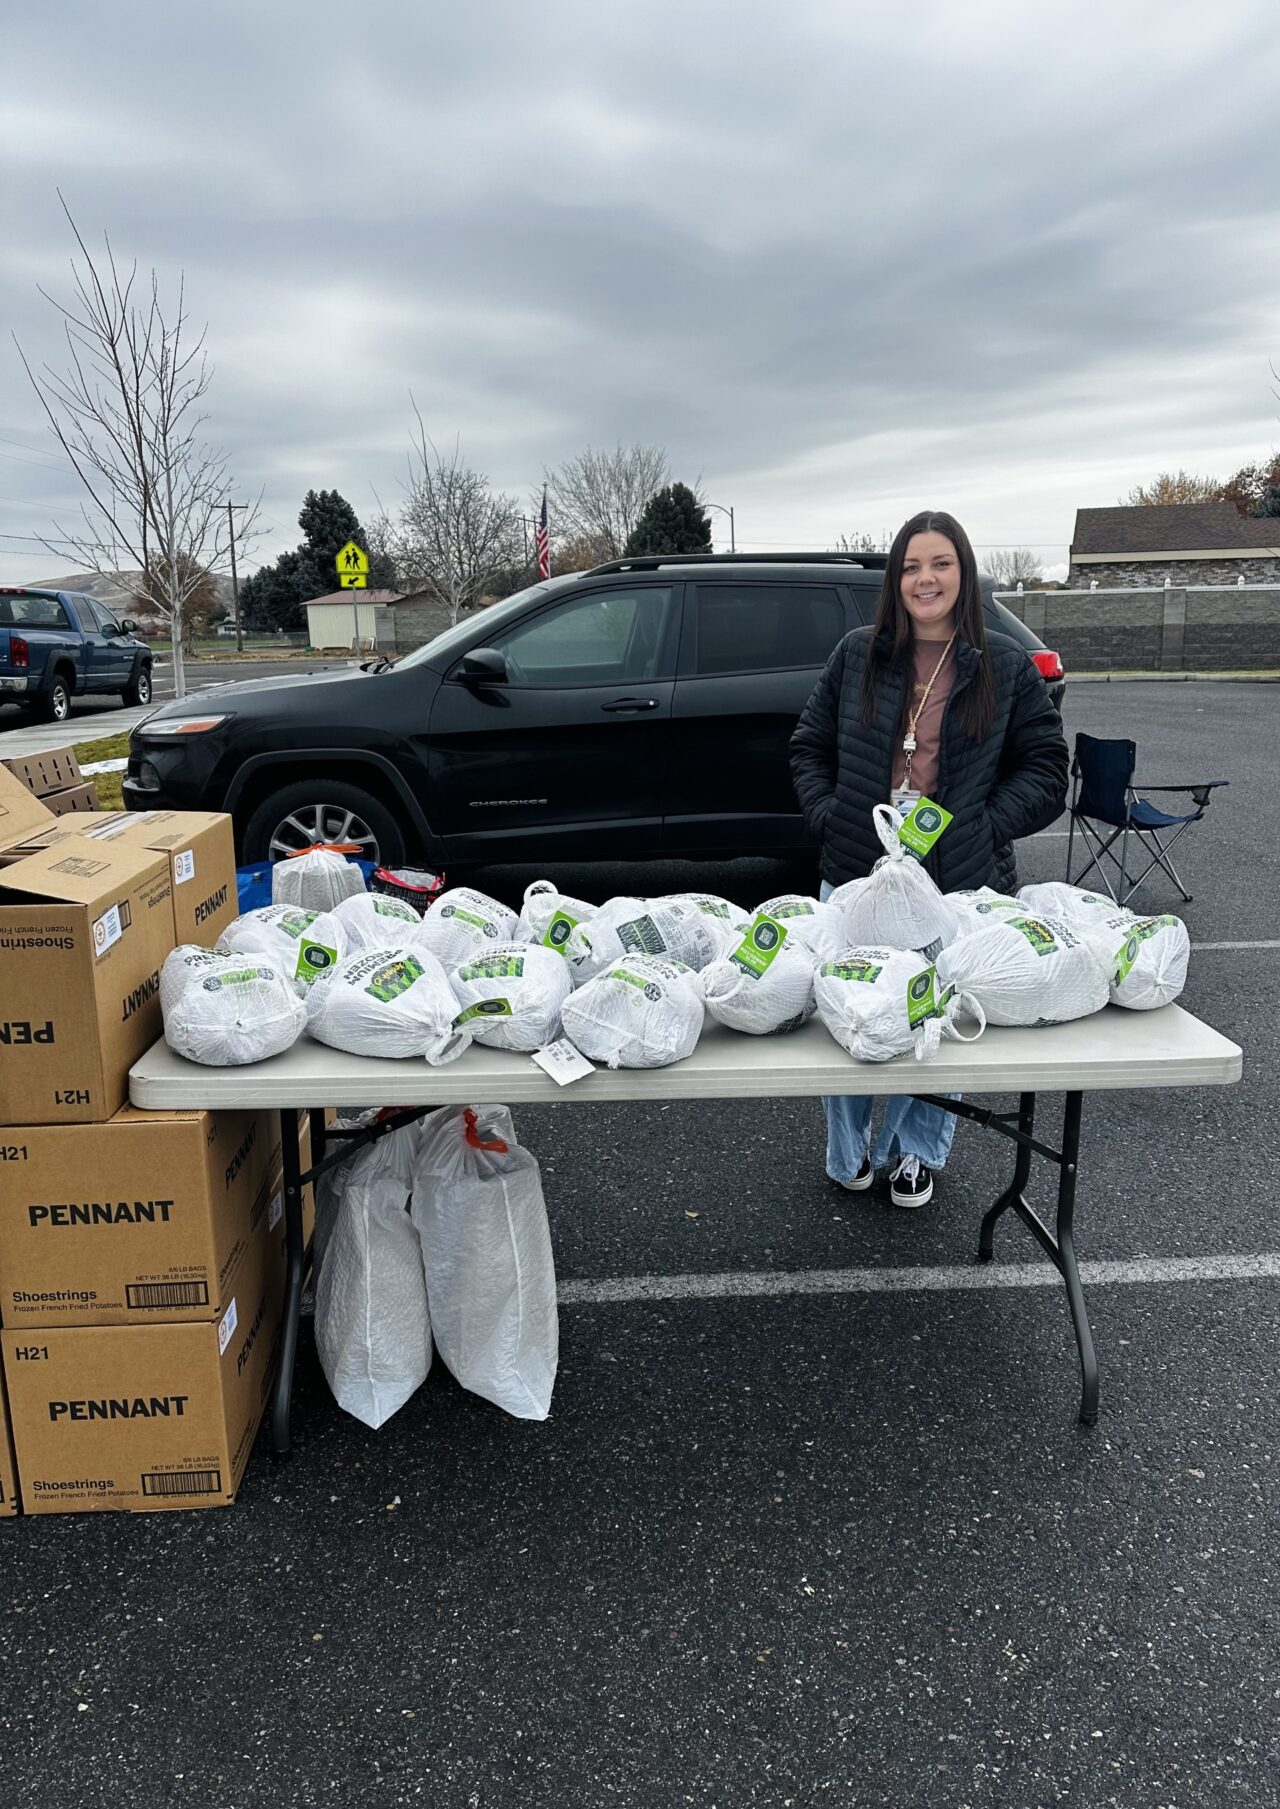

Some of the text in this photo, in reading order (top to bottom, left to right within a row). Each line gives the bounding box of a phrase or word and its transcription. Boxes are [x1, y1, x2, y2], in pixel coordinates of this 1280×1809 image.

[469, 798, 548, 807] CHEROKEE
[194, 884, 228, 926] PENNANT
[14, 926, 43, 935] French
[45, 926, 73, 934] Frozen
[343, 950, 392, 980] FROZEN
[347, 949, 404, 986] PREMIUM
[121, 969, 161, 1022] ENNANT
[54, 1089, 90, 1105] H21
[225, 1121, 257, 1191] PENNANT
[28, 1200, 174, 1227] PENNANT
[189, 1265, 207, 1273] BAGS
[12, 1289, 97, 1303] Shoestrings
[14, 1302, 123, 1313] Frozen French Fried Potatoes
[15, 1347, 49, 1361] H21
[48, 1396, 189, 1421] PENNANT
[33, 1479, 114, 1492] Shoestrings
[61, 1492, 86, 1500] French
[108, 1489, 139, 1498] Potatoes
